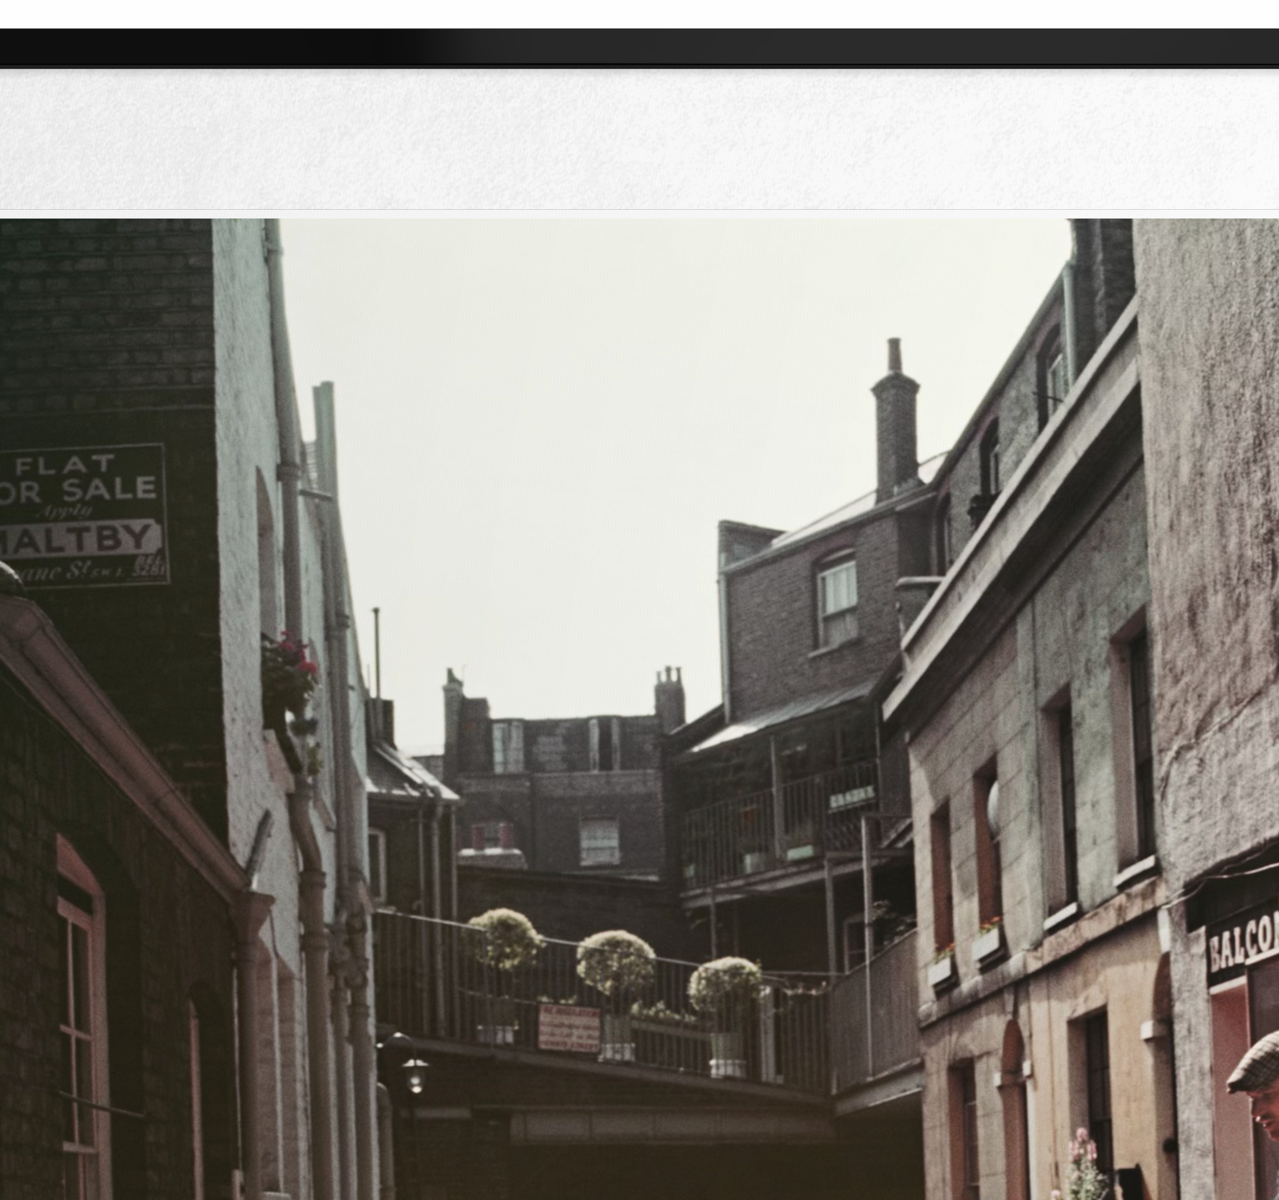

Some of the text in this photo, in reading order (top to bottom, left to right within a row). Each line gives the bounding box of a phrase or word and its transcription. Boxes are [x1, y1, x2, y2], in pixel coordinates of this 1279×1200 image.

[15, 453, 116, 477] FLAT
[62, 475, 157, 502] SALE
[35, 503, 94, 521] Apply
